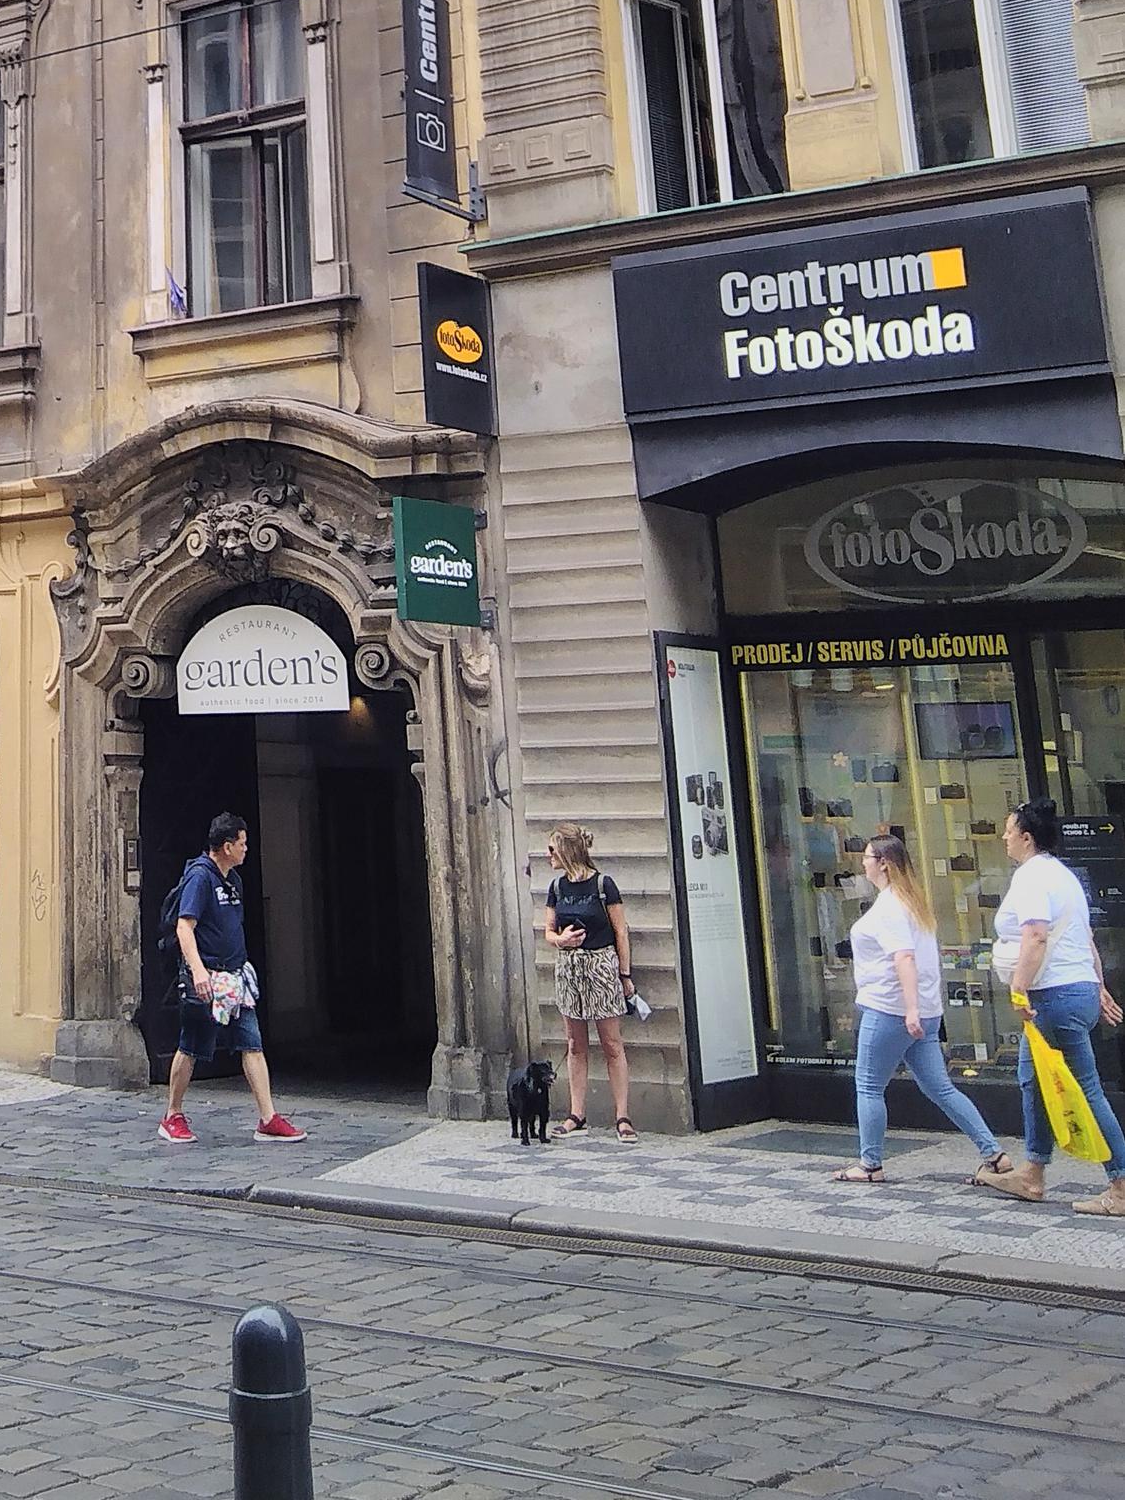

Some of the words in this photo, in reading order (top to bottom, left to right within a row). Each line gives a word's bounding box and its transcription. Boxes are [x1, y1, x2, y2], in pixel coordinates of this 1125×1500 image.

[719, 252, 935, 317] Centrum
[724, 305, 975, 379] FotoŠkoda
[410, 554, 473, 579] garden's
[218, 620, 298, 643] RESTAURANT
[731, 642, 803, 665] PRODEJ
[817, 640, 884, 663] SERVIS
[898, 633, 1009, 660] PŮJČOVNA
[200, 698, 241, 707] authentic
[245, 697, 265, 706] food
[275, 697, 299, 705] since
[303, 696, 324, 704] 2014
